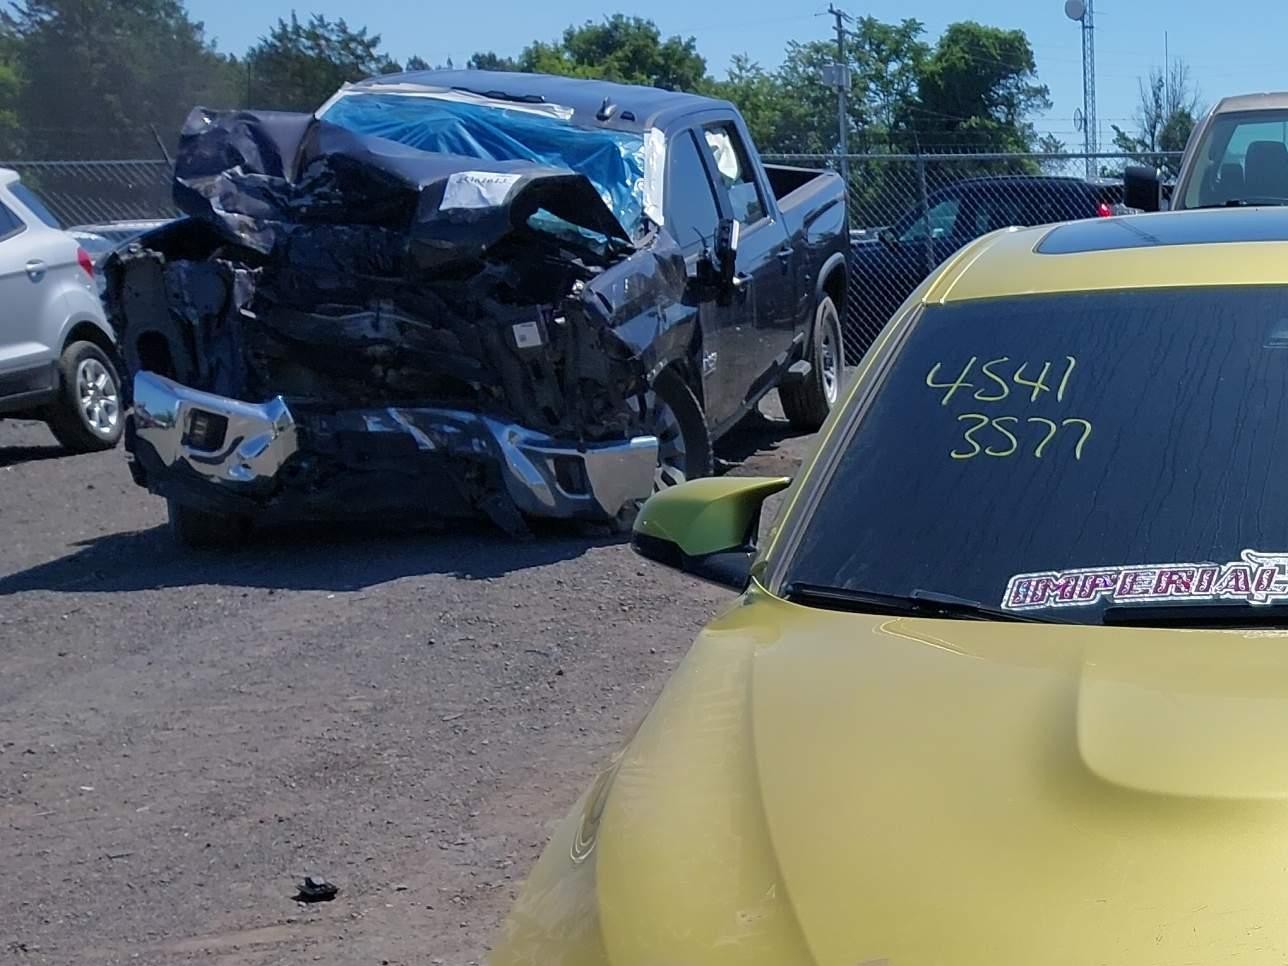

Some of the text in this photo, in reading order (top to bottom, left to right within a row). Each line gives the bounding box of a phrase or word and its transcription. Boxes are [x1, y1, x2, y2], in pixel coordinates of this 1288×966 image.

[926, 356, 1076, 406] 4541
[950, 413, 1092, 460] 3577
[1006, 564, 1288, 607] IMPERIAL
